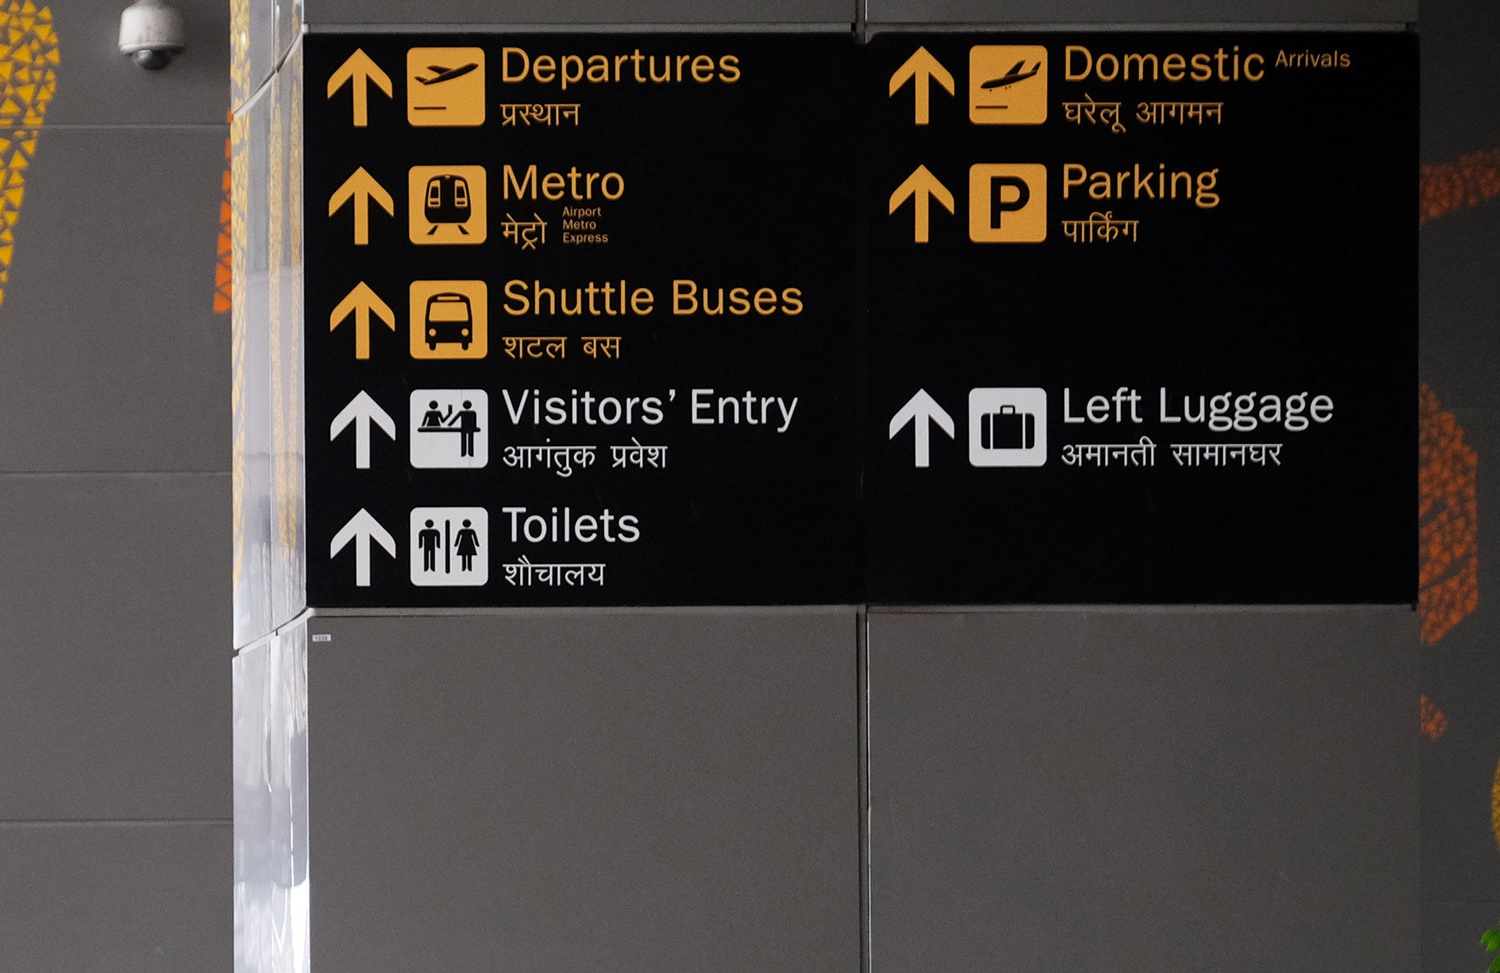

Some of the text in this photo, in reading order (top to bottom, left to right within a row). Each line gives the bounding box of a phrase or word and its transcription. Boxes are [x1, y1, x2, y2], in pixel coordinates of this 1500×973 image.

[502, 47, 740, 90] Departures
[1065, 46, 1350, 81] Domestic Arrivals
[500, 104, 580, 126] प्रस्थान
[1062, 93, 1223, 133] घरेलू आगमन
[503, 165, 624, 200] Metro
[1063, 163, 1220, 208] Parking
[563, 207, 601, 218] Airport
[990, 175, 1031, 229] P
[501, 213, 548, 250] मेट्रो
[563, 219, 596, 230] Metro
[563, 232, 608, 244] Express
[1062, 211, 1139, 243] पार्किंग
[503, 280, 803, 315] Shuttle Buses
[502, 337, 622, 359] शटल बस
[502, 389, 798, 432] Visitors’ Entry
[1064, 387, 1333, 431] Left Luggage
[503, 437, 668, 477] आगंतुक प्रवेश
[1062, 436, 1283, 466] अमानती सामानघर
[502, 507, 640, 542] Toilets
[502, 554, 606, 586] शौचालय
